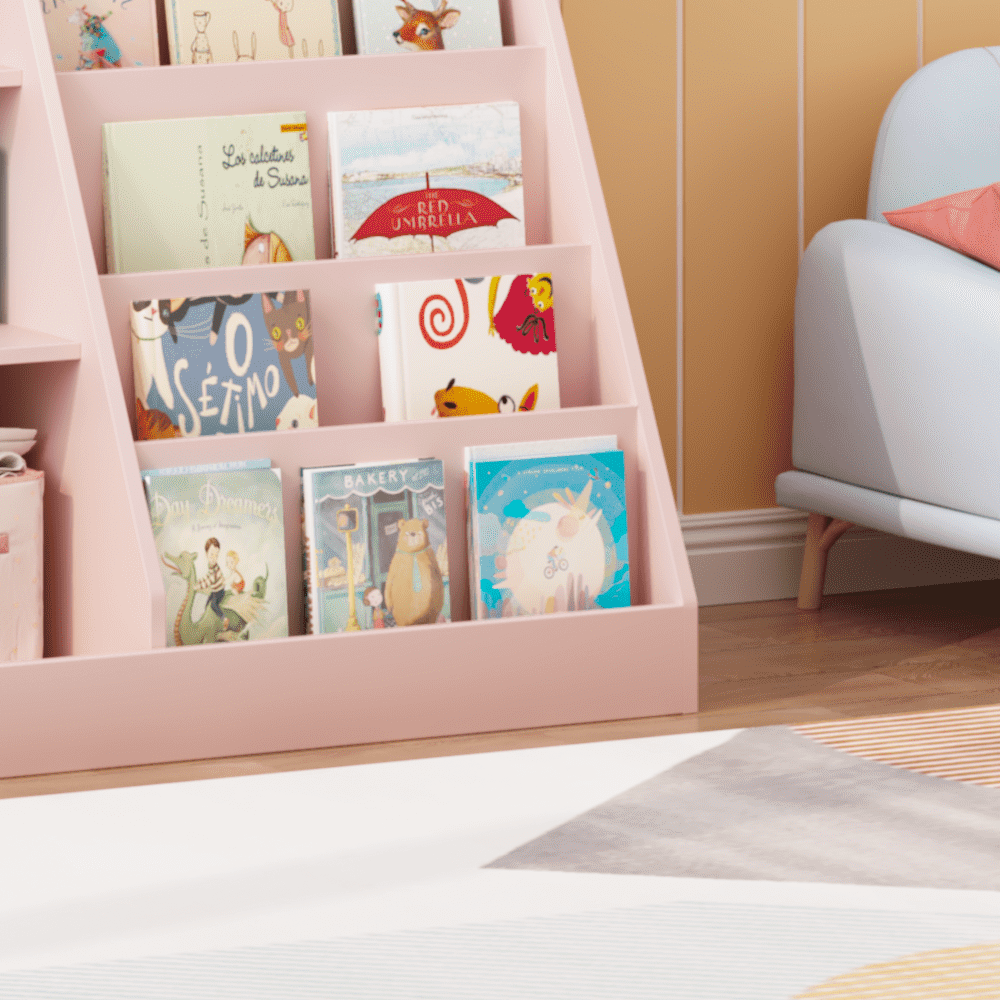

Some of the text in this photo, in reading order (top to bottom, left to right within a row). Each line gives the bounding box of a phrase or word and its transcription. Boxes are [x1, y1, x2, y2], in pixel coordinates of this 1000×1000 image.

[222, 144, 295, 170] Los calcetines
[253, 166, 309, 188] de Susana
[417, 200, 449, 215] RED
[391, 211, 478, 231] UMBRELLA
[224, 312, 253, 377] O
[344, 469, 409, 489] BAKERY
